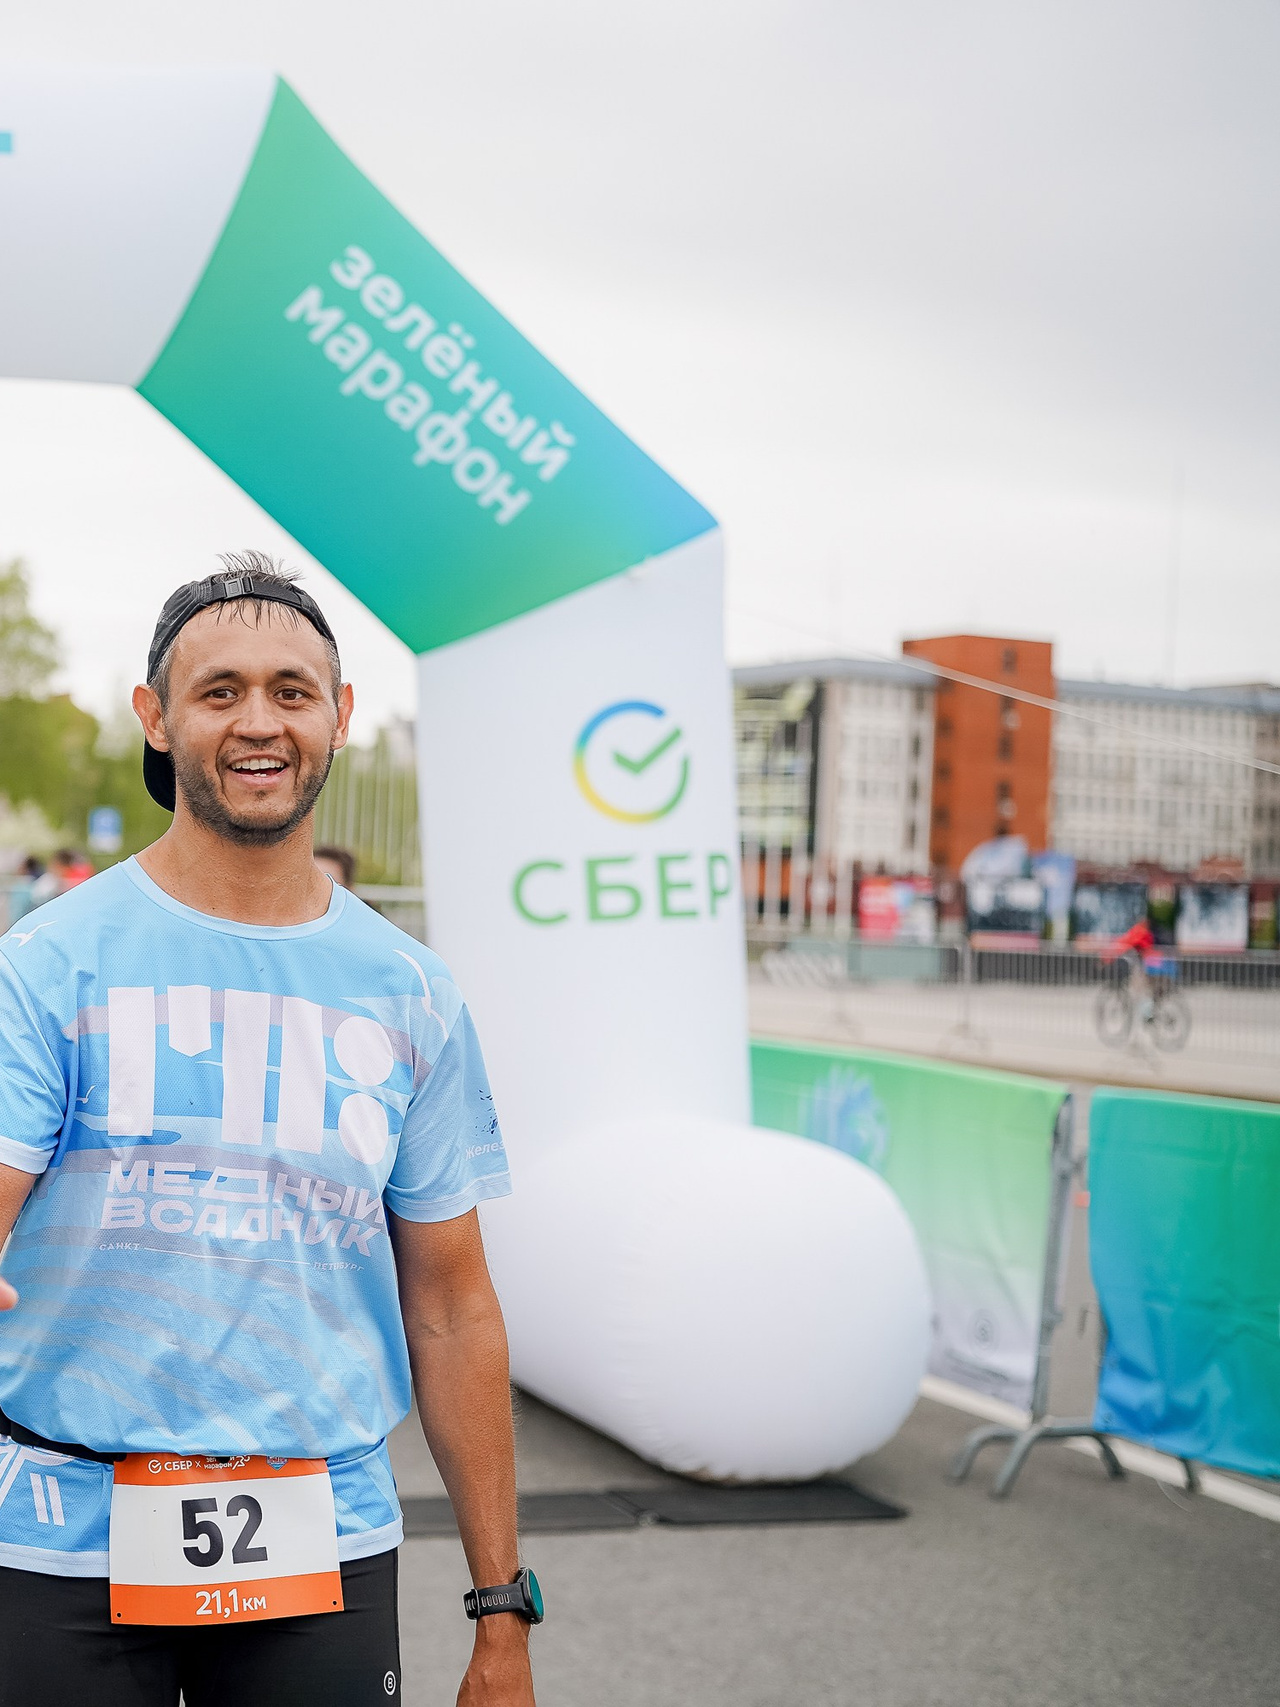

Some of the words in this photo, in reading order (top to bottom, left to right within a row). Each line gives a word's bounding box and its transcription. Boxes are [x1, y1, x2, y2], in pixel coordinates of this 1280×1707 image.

[329, 244, 576, 482] зелёный
[284, 284, 532, 526] марафон
[512, 854, 733, 925] СБЕР
[100, 1197, 381, 1257] ВСАДНИК
[313, 1262, 365, 1272] ПЕТБУРГ
[164, 1460, 193, 1471] СБЕР
[181, 1494, 268, 1567] 52
[195, 1588, 239, 1618] 21,1
